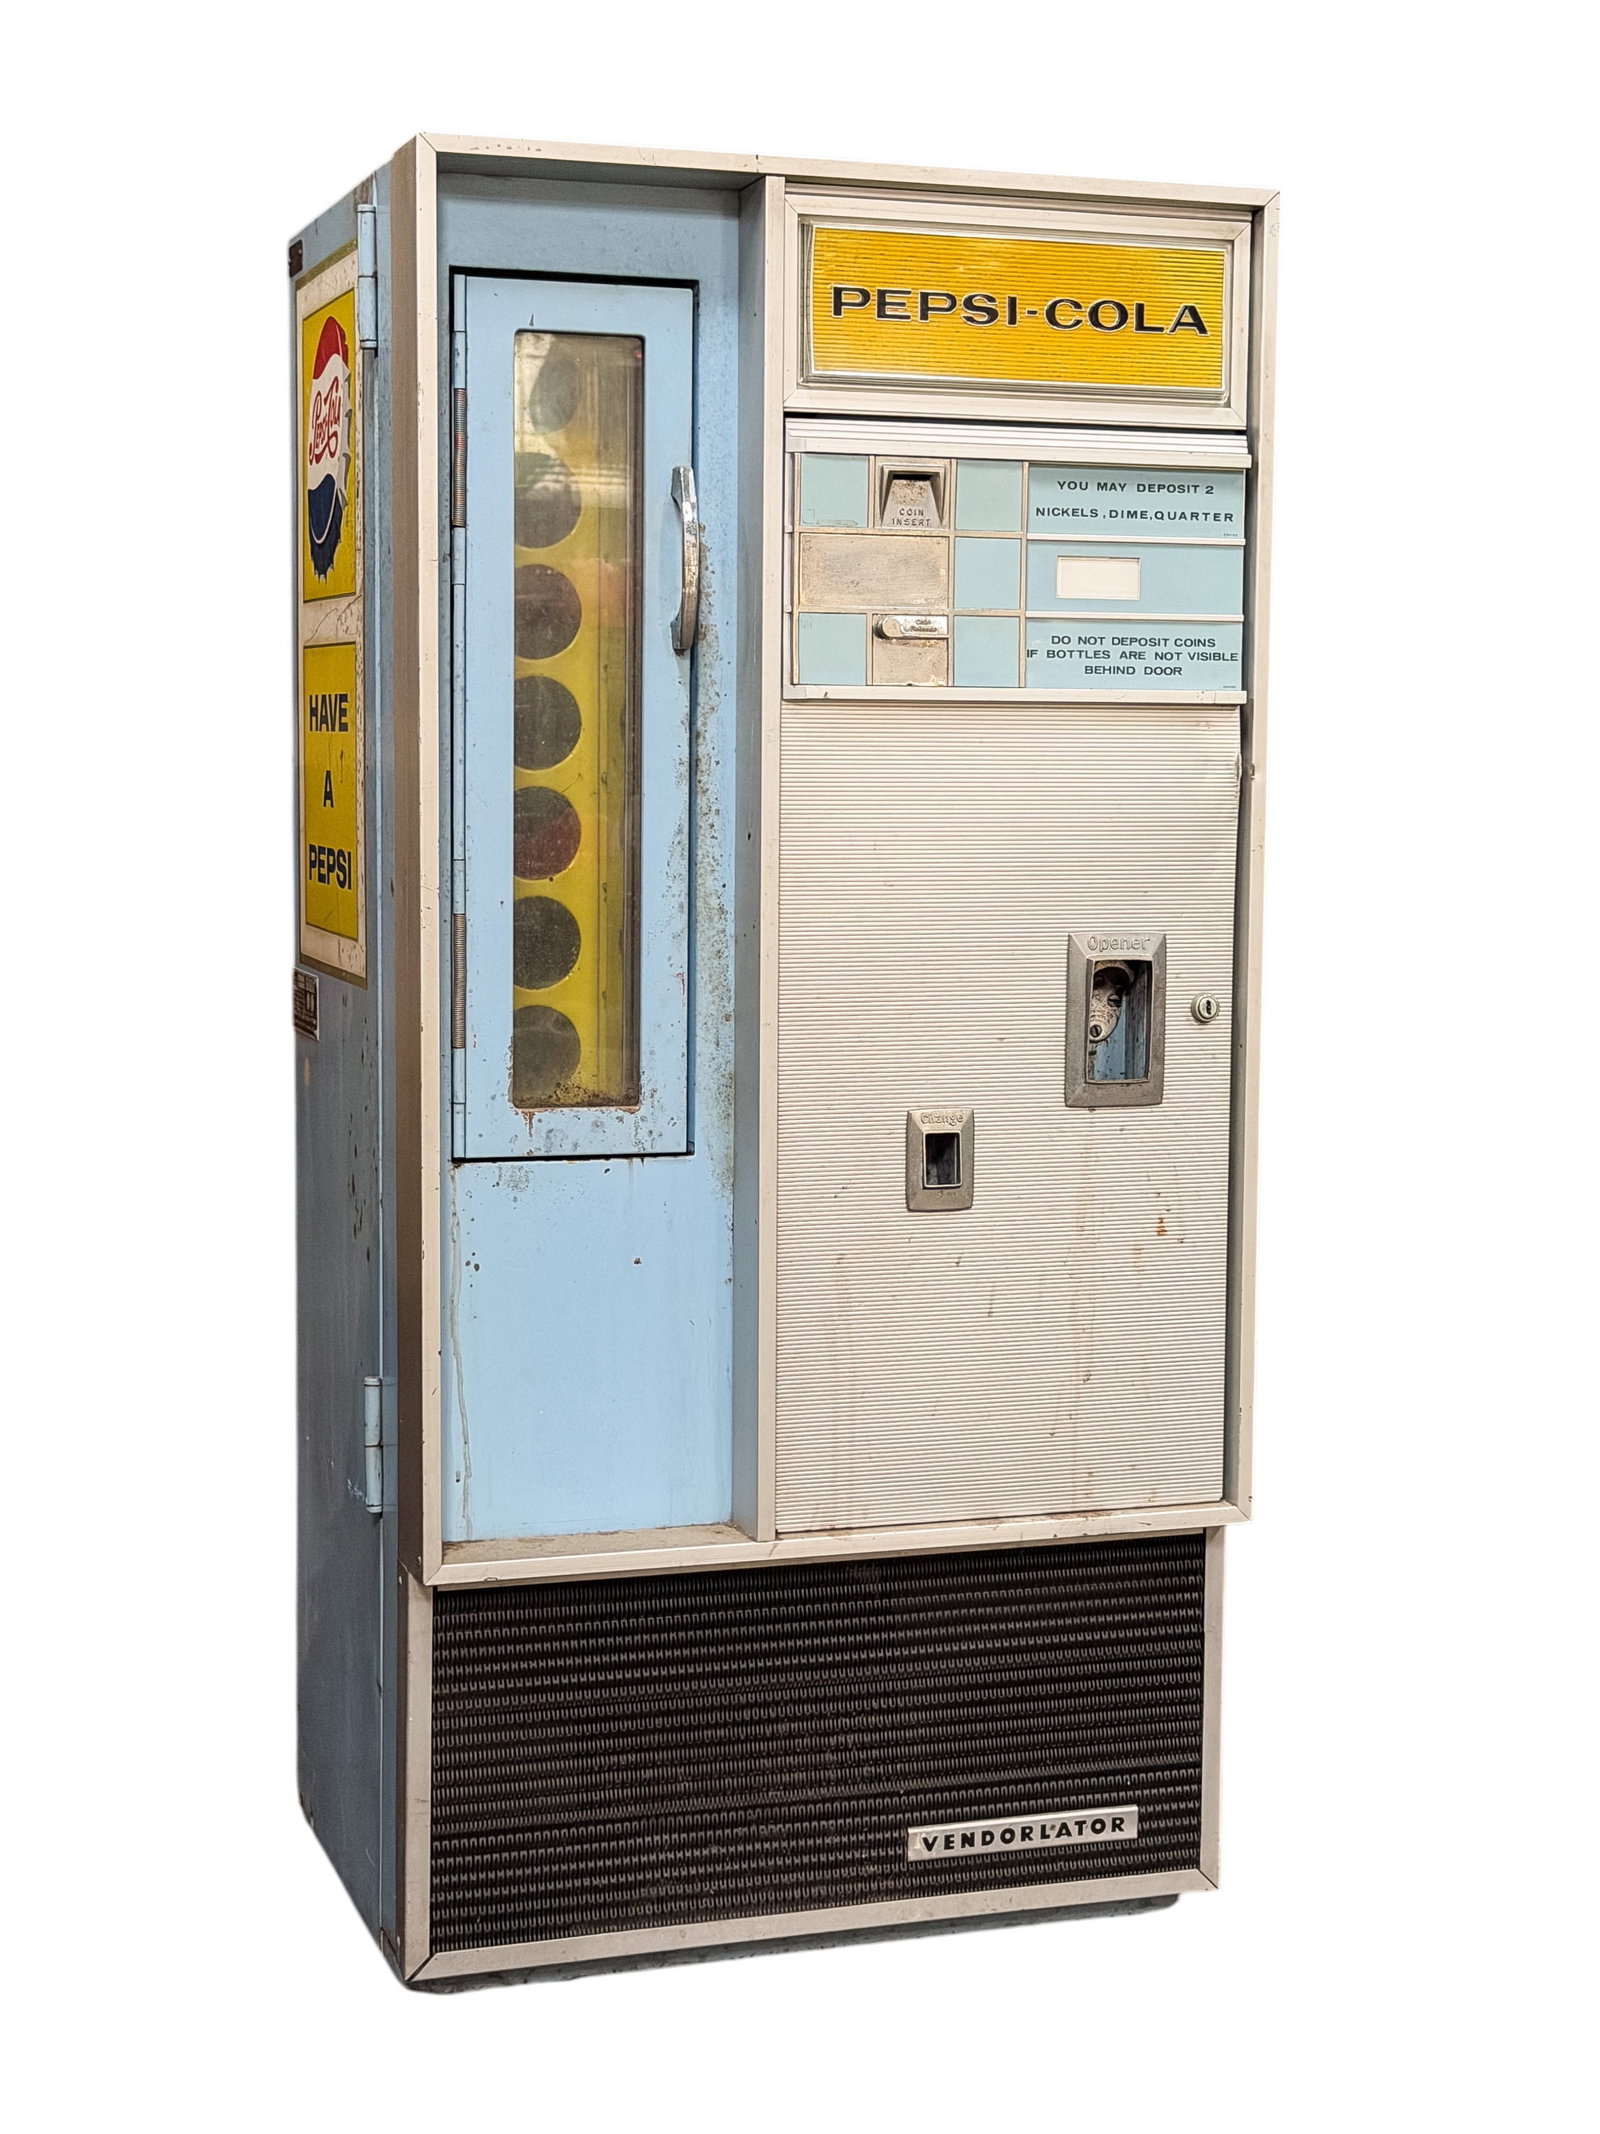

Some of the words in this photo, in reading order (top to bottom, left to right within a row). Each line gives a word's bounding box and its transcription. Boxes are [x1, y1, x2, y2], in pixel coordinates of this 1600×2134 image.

[831, 284, 1211, 336] PEPSI-COLA
[1057, 481, 1089, 491] YOU
[1096, 482, 1127, 492] MAY
[1136, 483, 1200, 494] DEPOSIT
[1204, 486, 1215, 495] 2
[899, 508, 924, 517] COIN
[892, 518, 931, 527] INSERT
[1051, 635, 1071, 645] DO
[1077, 636, 1106, 646] NOT
[1111, 637, 1170, 647] DEPOSIT
[1173, 638, 1216, 648] COINS
[1026, 649, 1038, 658] IF
[1046, 649, 1111, 659] BOTTLES
[1119, 650, 1146, 660] ARE
[1154, 651, 1182, 661] NOT
[1187, 652, 1239, 661] VISIBLE
[1084, 665, 1136, 675] BEHIND
[1143, 666, 1183, 676] DOOR
[308, 693, 350, 733] HAVE
[322, 769, 335, 809] A
[308, 843, 353, 891] PEPSI
[1086, 935, 1151, 953] Opener
[920, 1112, 964, 1127] Change
